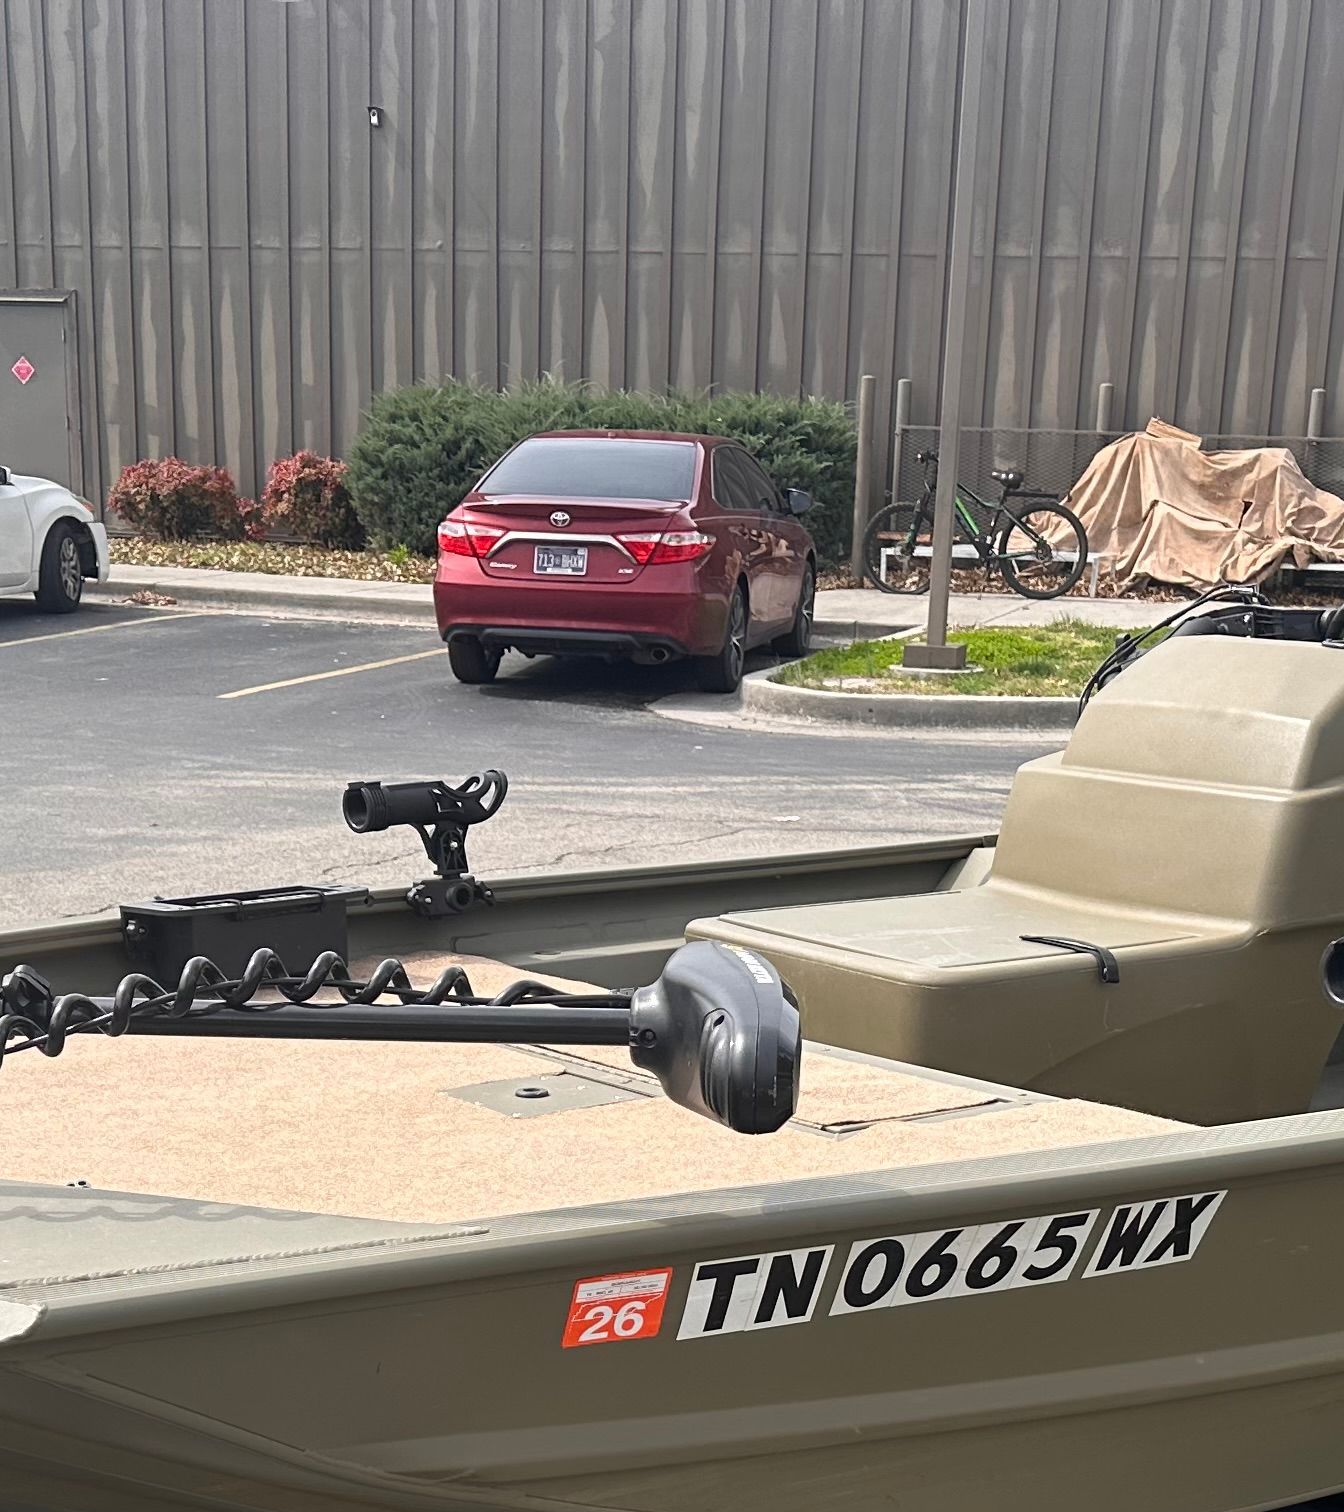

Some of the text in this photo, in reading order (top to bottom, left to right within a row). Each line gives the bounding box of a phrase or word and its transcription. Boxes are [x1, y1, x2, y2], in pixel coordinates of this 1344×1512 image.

[698, 1190, 1221, 1331] TN 0665 WX
[578, 1301, 646, 1342] 26
